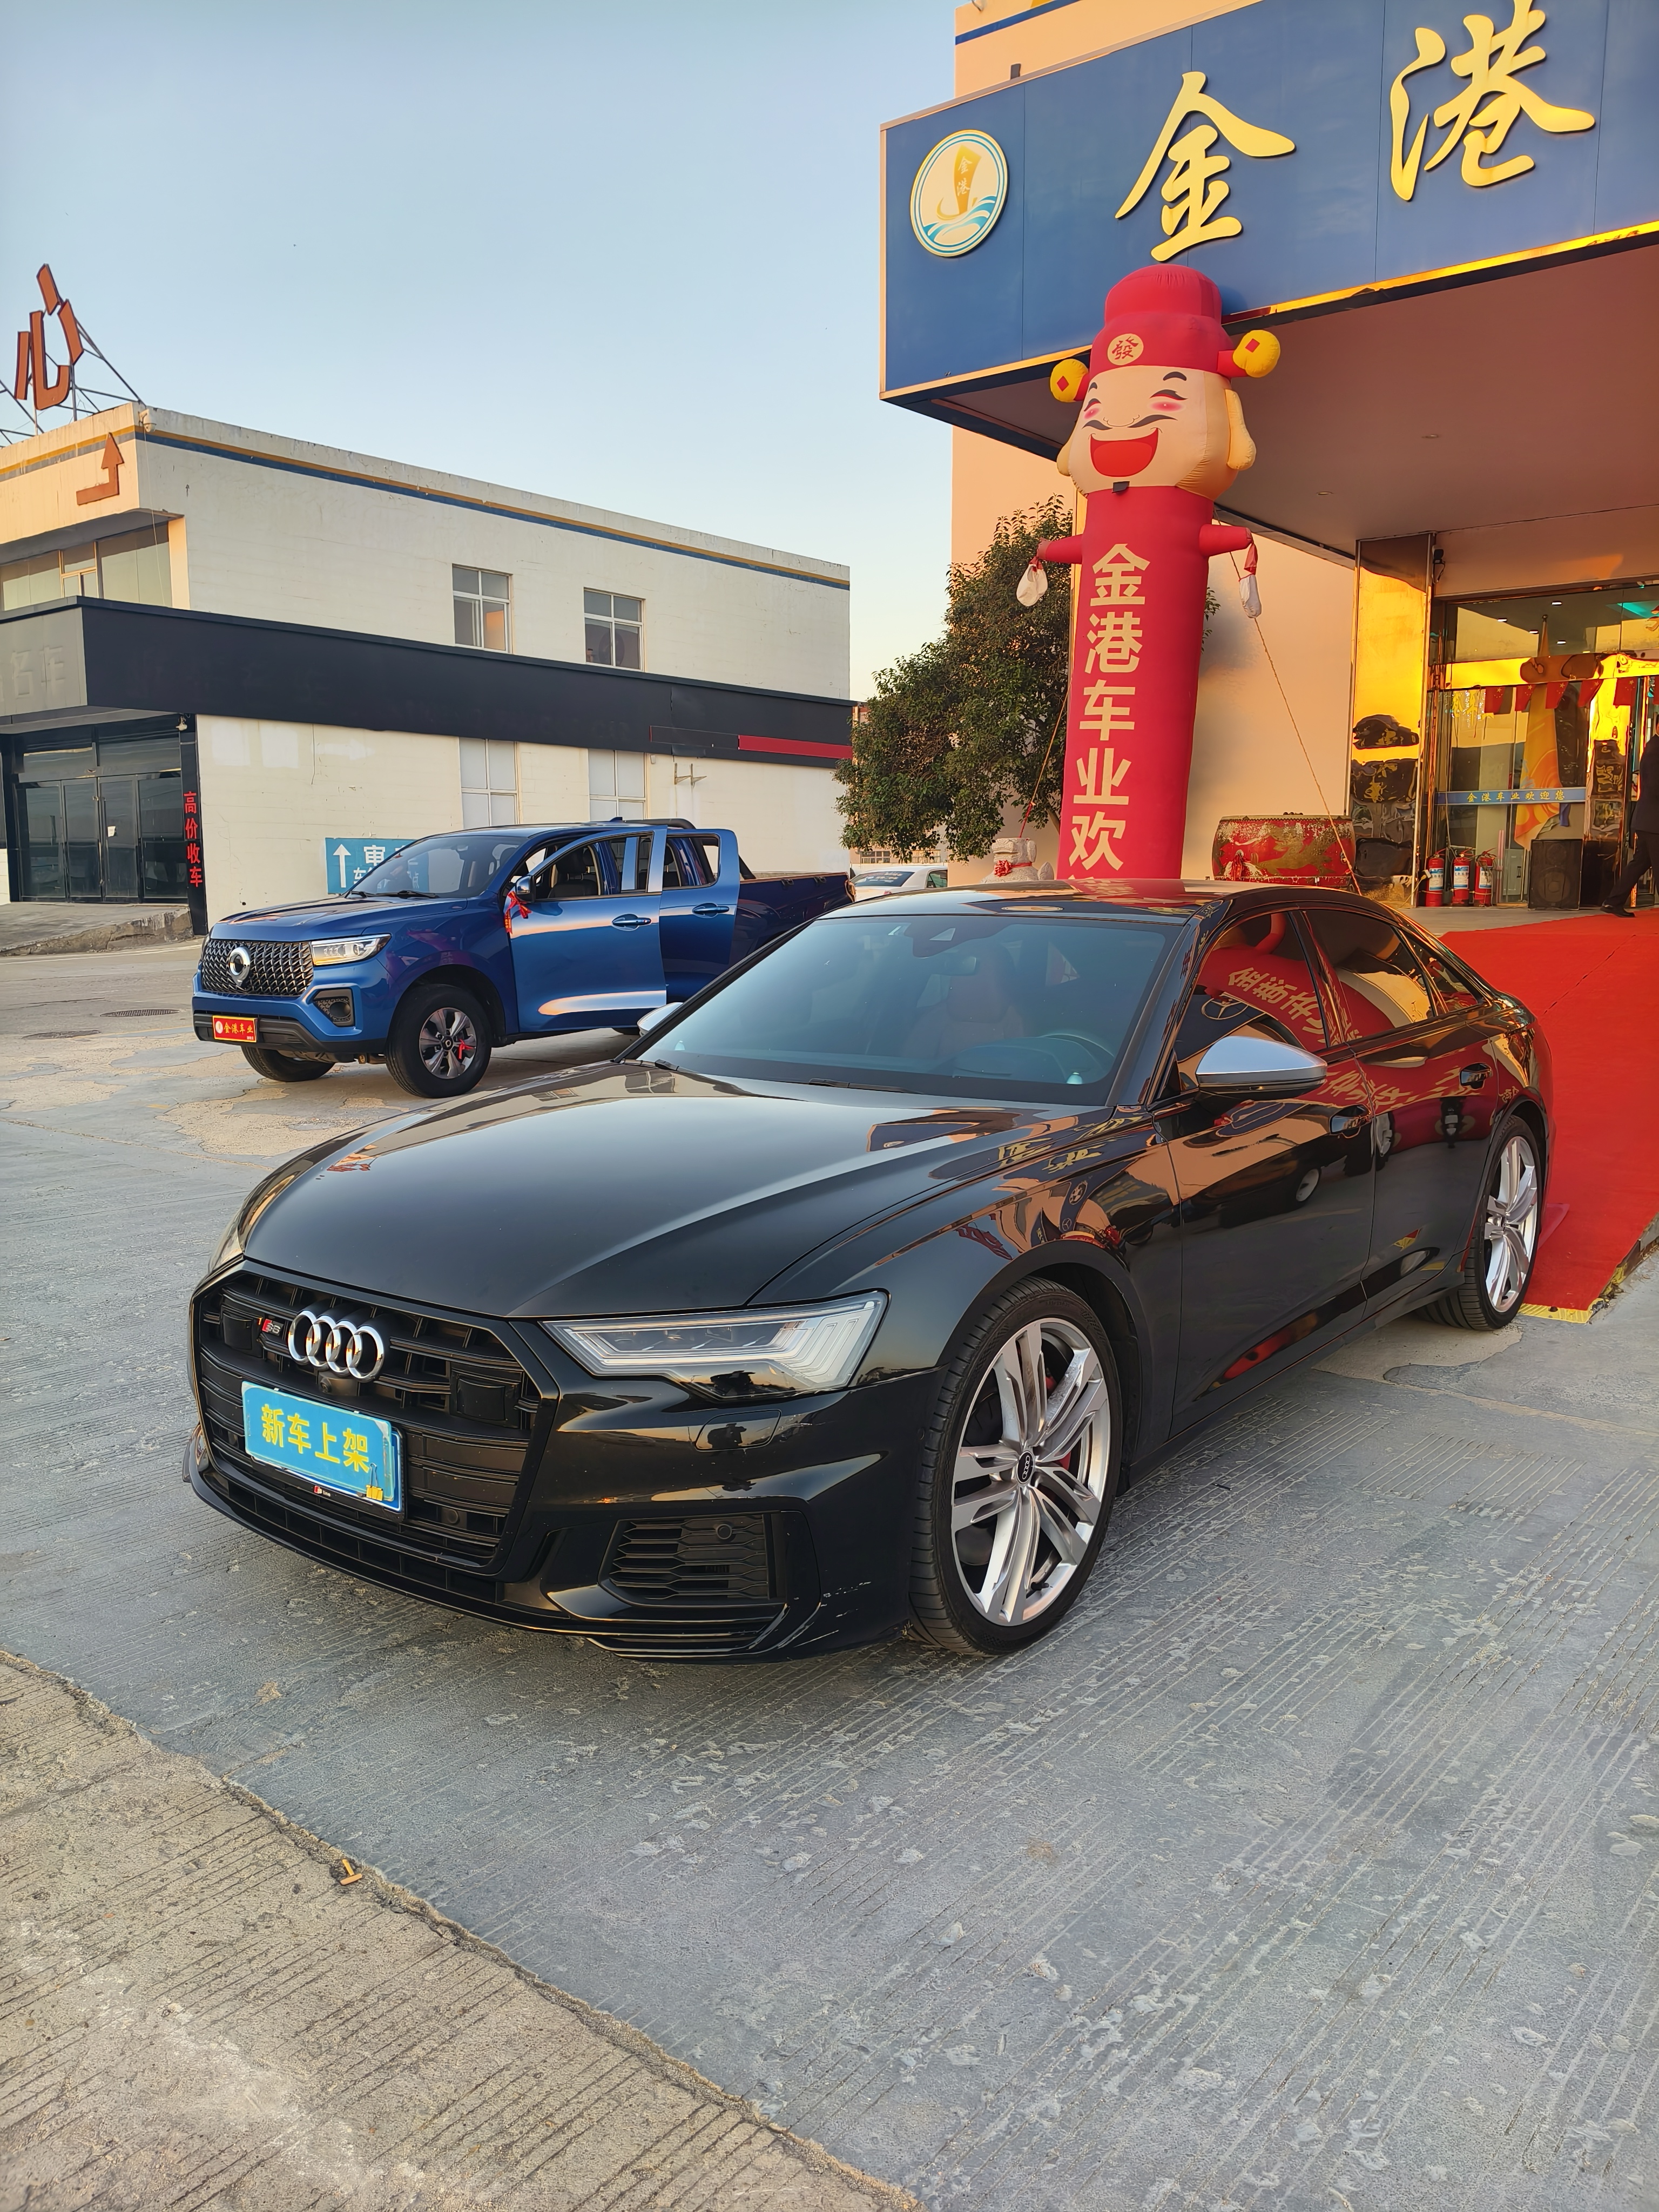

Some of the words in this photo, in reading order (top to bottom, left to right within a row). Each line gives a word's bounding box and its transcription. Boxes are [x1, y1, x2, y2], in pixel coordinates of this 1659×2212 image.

[1115, 0, 1595, 261] 金港
[958, 156, 972, 196] 金港
[15, 263, 84, 410] 心
[1112, 336, 1139, 360] 發
[0, 645, 65, 700] 名车
[1068, 543, 1150, 879] 金港车业欢
[1467, 790, 1565, 802] 金港车业欢迎您
[184, 791, 203, 887] 高价收车
[224, 1022, 254, 1035] 金港车业
[261, 1404, 370, 1473] 新车上架
